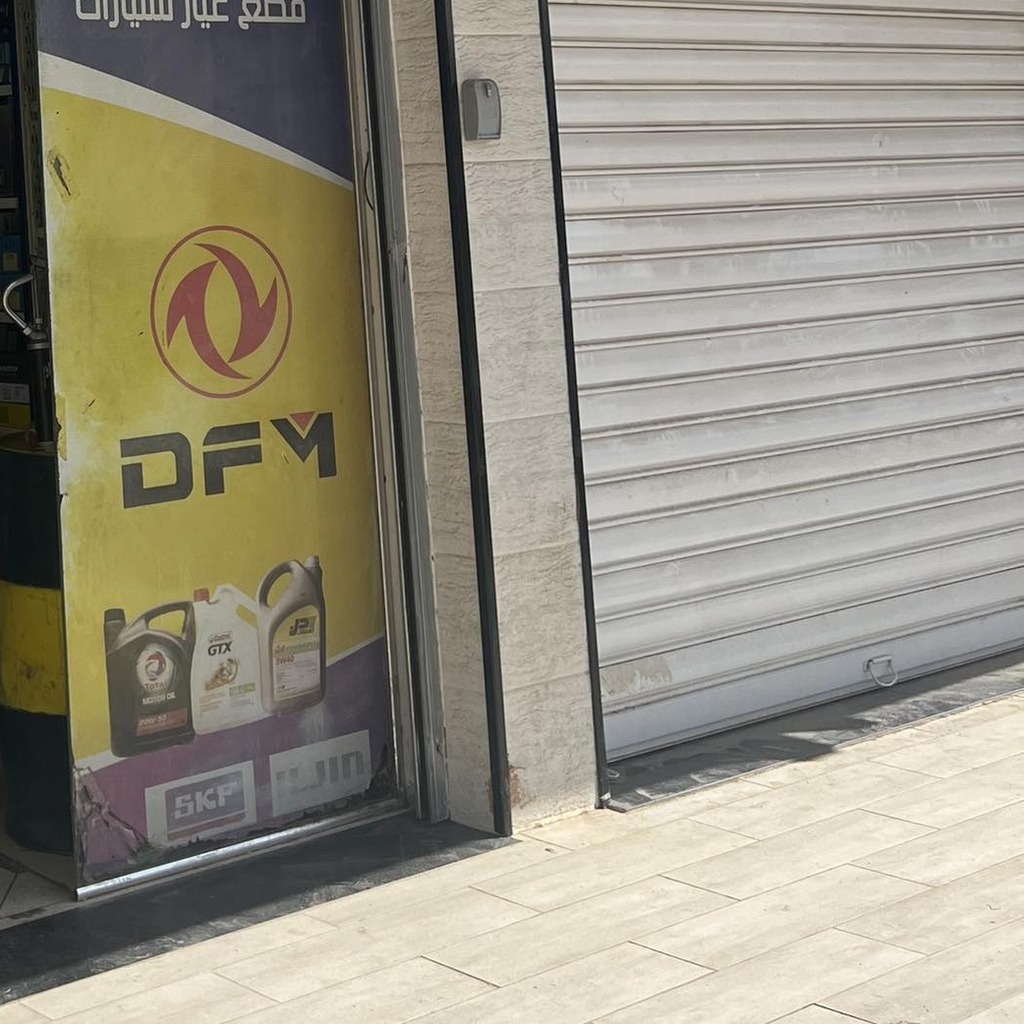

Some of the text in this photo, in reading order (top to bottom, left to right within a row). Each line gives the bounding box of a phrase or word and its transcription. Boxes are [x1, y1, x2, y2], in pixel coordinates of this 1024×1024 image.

[119, 411, 337, 509] DFM
[207, 641, 233, 656] GTX
[174, 779, 239, 820] SKF
